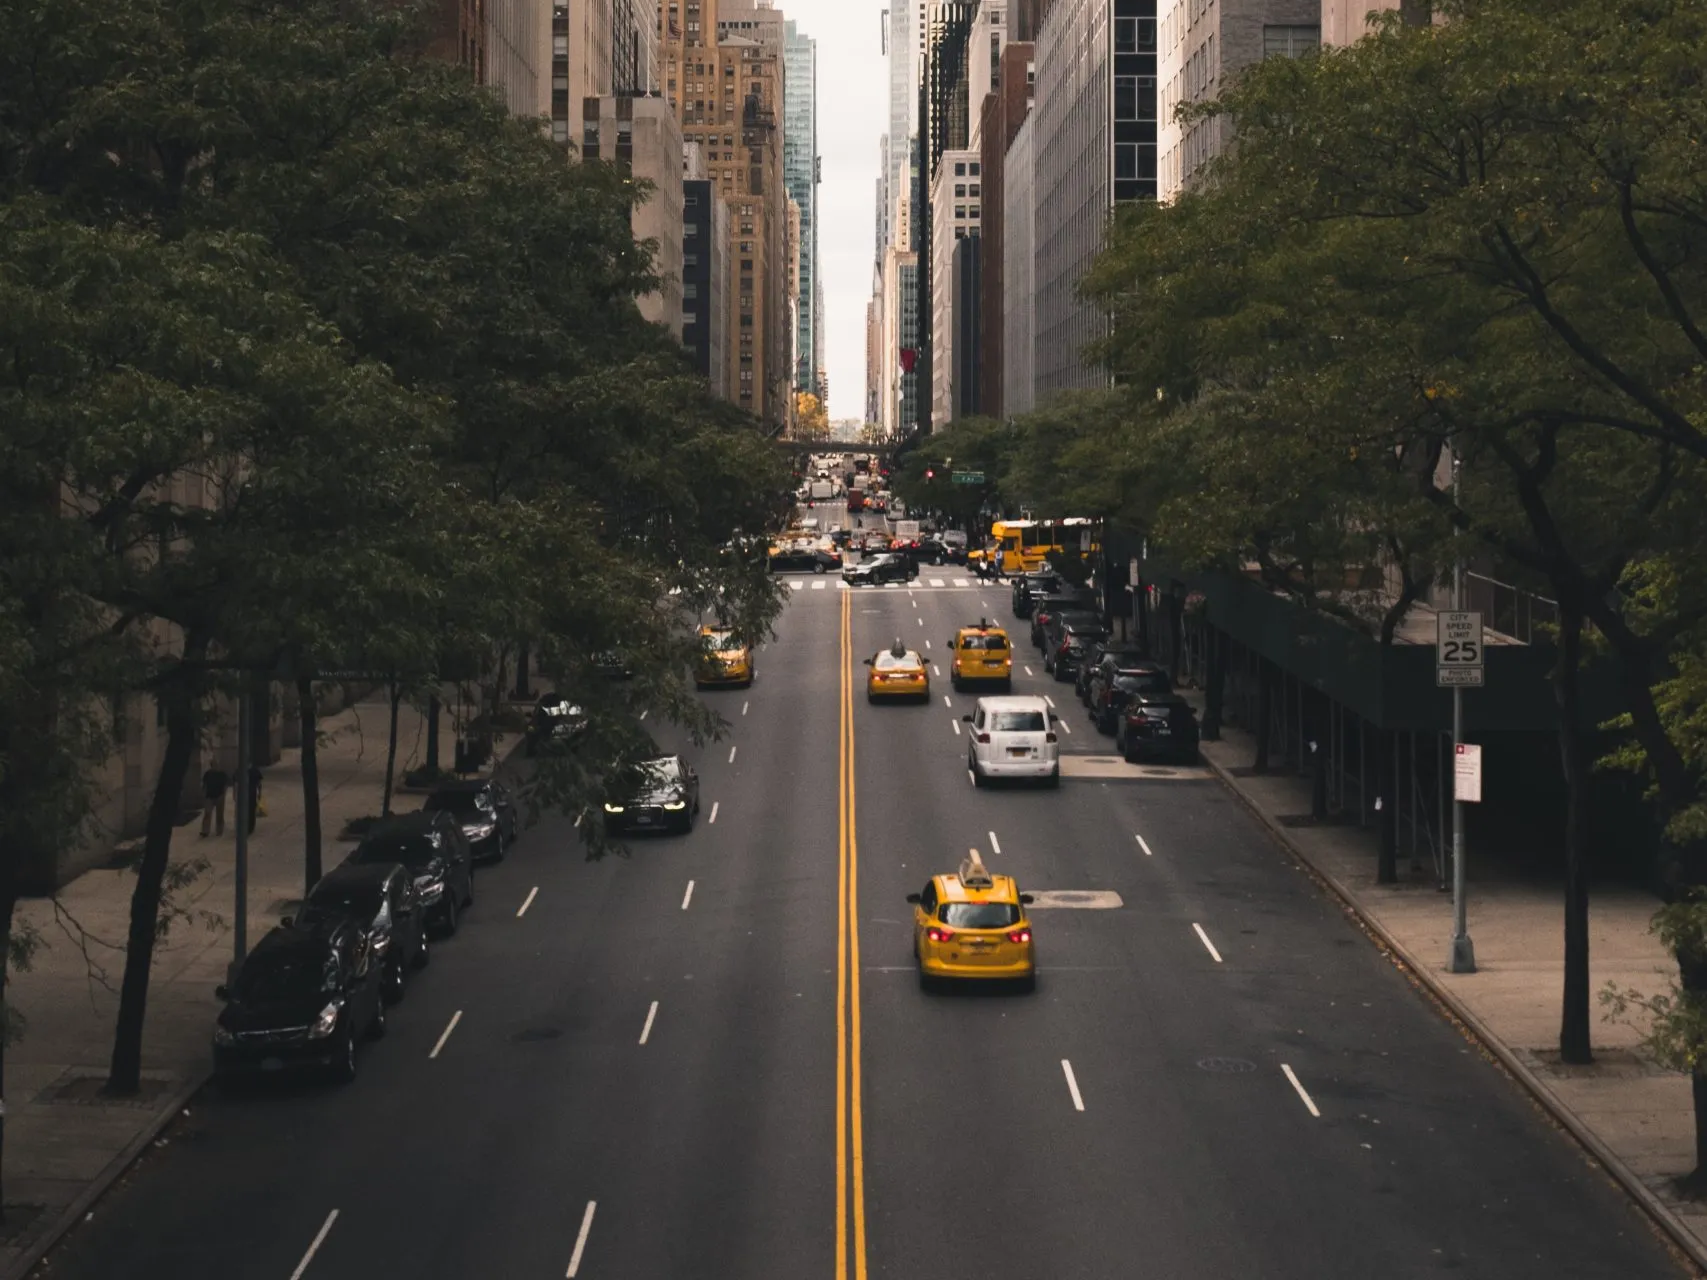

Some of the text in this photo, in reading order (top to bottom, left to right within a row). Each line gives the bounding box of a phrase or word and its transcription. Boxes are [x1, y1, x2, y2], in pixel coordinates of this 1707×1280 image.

[1446, 622, 1473, 630] SPEED
[1449, 631, 1470, 639] LIMIT
[1444, 641, 1477, 661] 25
